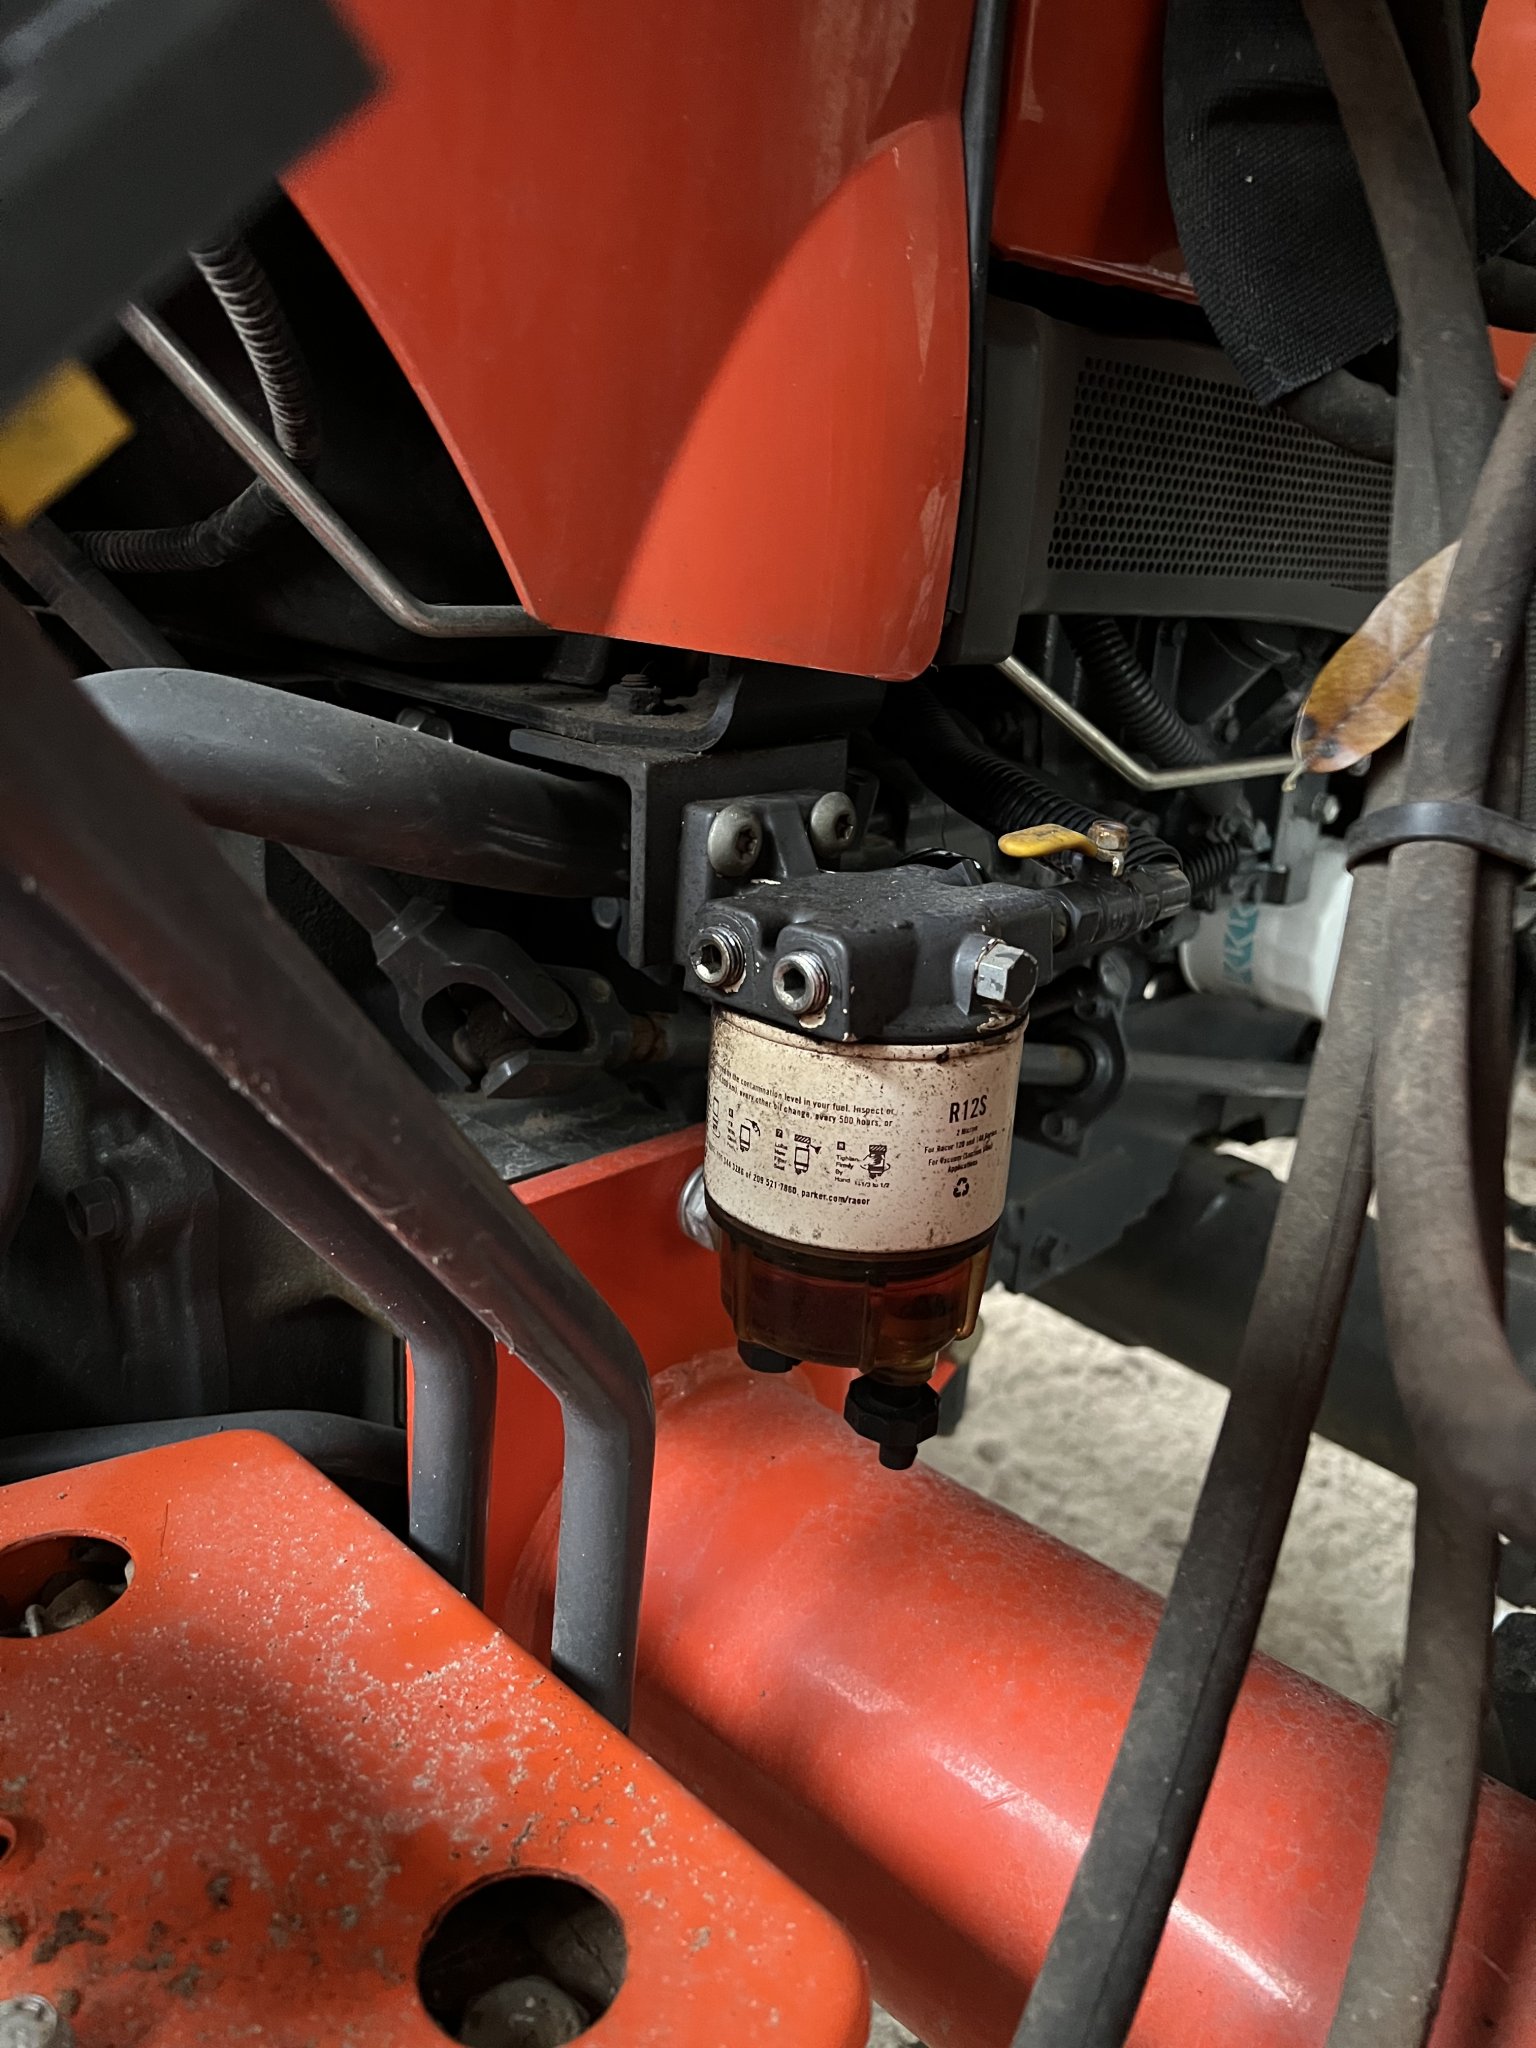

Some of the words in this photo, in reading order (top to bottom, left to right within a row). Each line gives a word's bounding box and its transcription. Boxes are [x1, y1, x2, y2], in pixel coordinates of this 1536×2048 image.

[784, 1093, 802, 1104] level
[803, 1097, 811, 1106] in
[812, 1100, 830, 1110] your
[832, 1103, 850, 1112] fuel.
[853, 1105, 884, 1116] Inspect
[949, 1094, 988, 1123] R12S
[815, 1113, 836, 1124] every
[839, 1115, 854, 1125] 500
[856, 1119, 881, 1127] hours,
[924, 1146, 935, 1154] For
[928, 1158, 939, 1166] For
[753, 1174, 764, 1184] 209
[765, 1178, 777, 1189] 521
[801, 1189, 870, 1205] parker.com/racor
